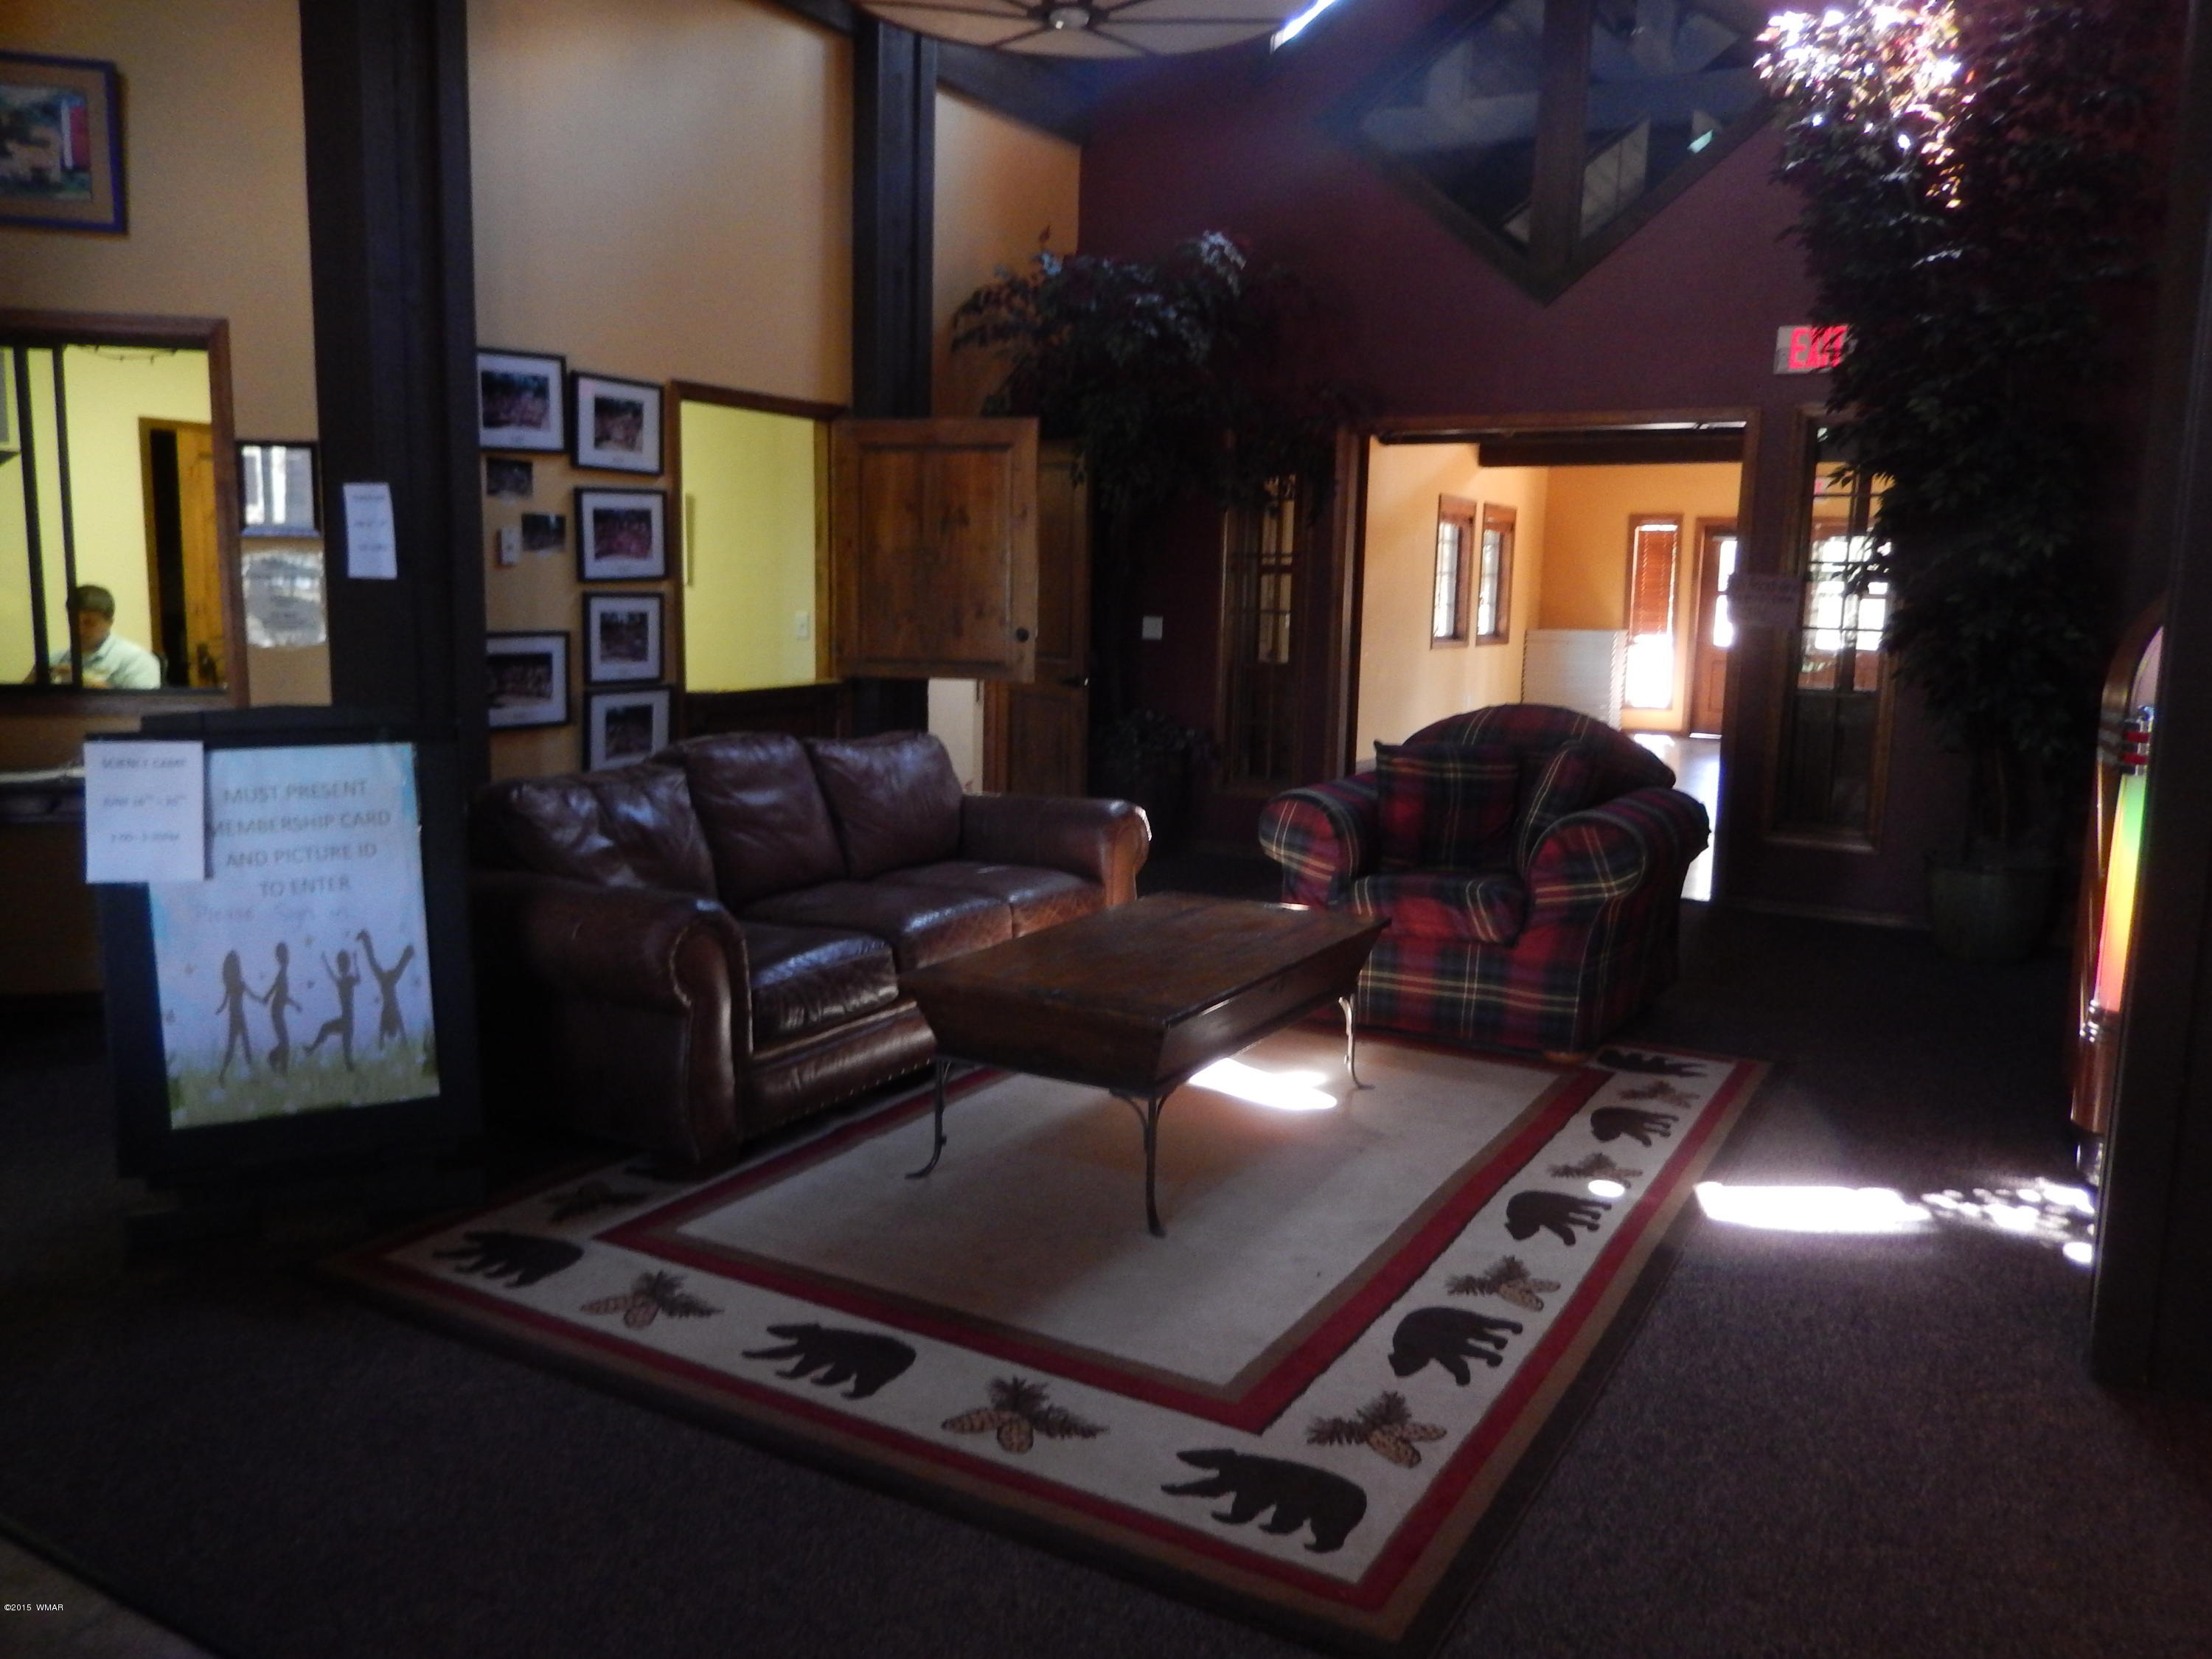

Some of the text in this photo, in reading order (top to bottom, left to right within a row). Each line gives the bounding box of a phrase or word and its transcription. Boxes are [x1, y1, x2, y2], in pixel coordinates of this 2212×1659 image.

[223, 779, 368, 804] MUST PRESENT
[207, 809, 392, 838] MEMBERSHIP CARD
[226, 842, 378, 867] AND PICTURE ID
[260, 874, 352, 897] TO ENTER
